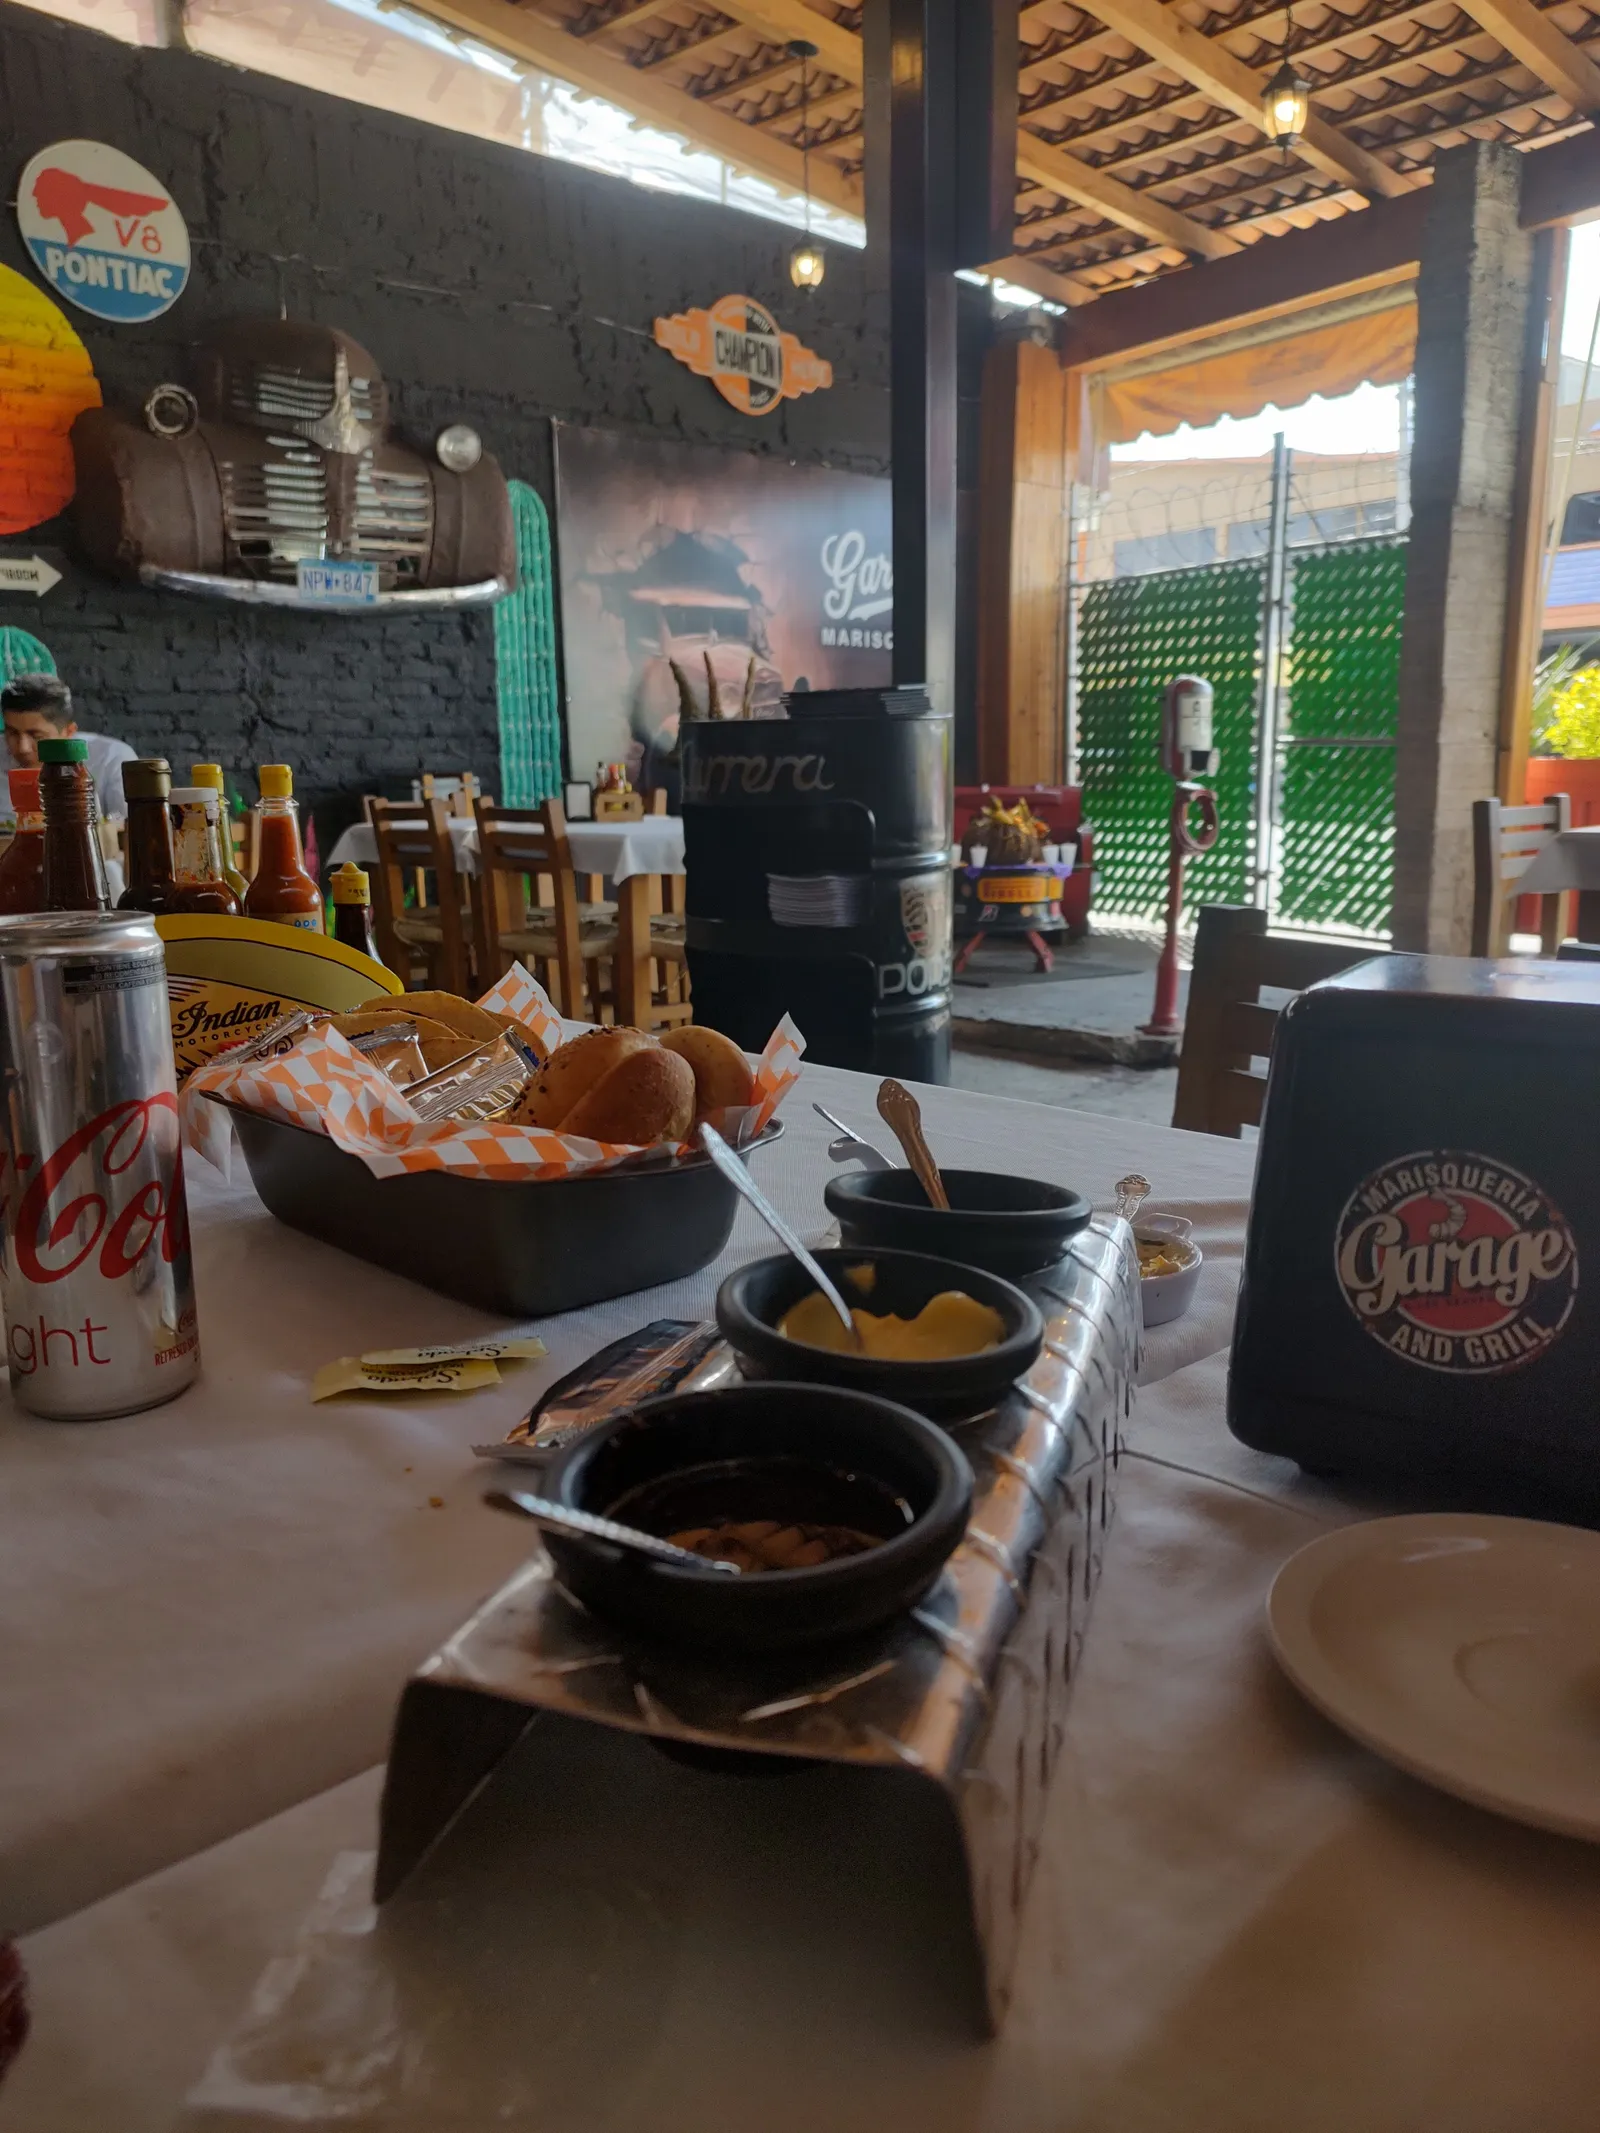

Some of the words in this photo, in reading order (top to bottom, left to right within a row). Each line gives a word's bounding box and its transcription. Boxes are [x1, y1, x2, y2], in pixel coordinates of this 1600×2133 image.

[114, 218, 162, 254] V8
[45, 247, 175, 299] PONTIAC
[820, 531, 894, 620] Gar
[172, 1000, 282, 1039] Indian
[175, 1022, 271, 1048] MOTORCYCL
[1362, 1163, 1541, 1220] MARISQUERIA
[1340, 1214, 1572, 1315] Garage
[11, 1315, 111, 1374] ght
[1390, 1324, 1453, 1363] AND
[1464, 1315, 1554, 1365] GRILL
